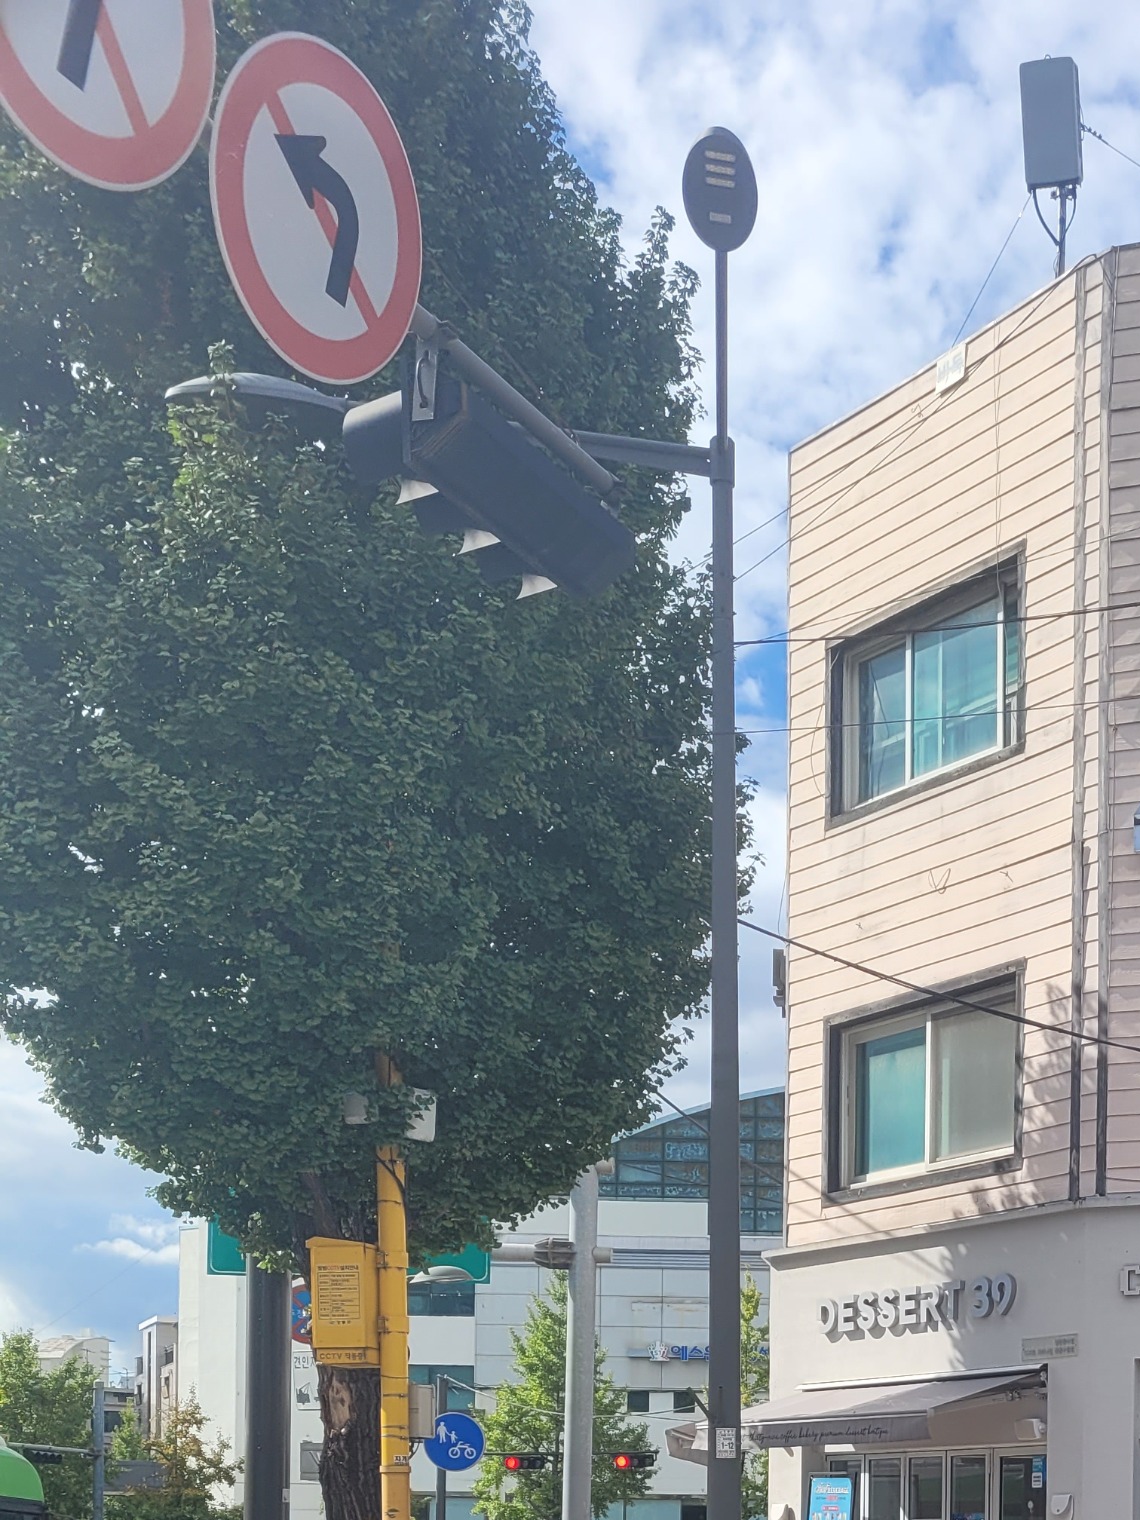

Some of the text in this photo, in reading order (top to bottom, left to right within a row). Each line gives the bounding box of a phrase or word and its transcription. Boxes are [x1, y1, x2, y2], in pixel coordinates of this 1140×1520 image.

[817, 1272, 1017, 1338] DESSERT 39
[320, 1352, 343, 1360] CCTV
